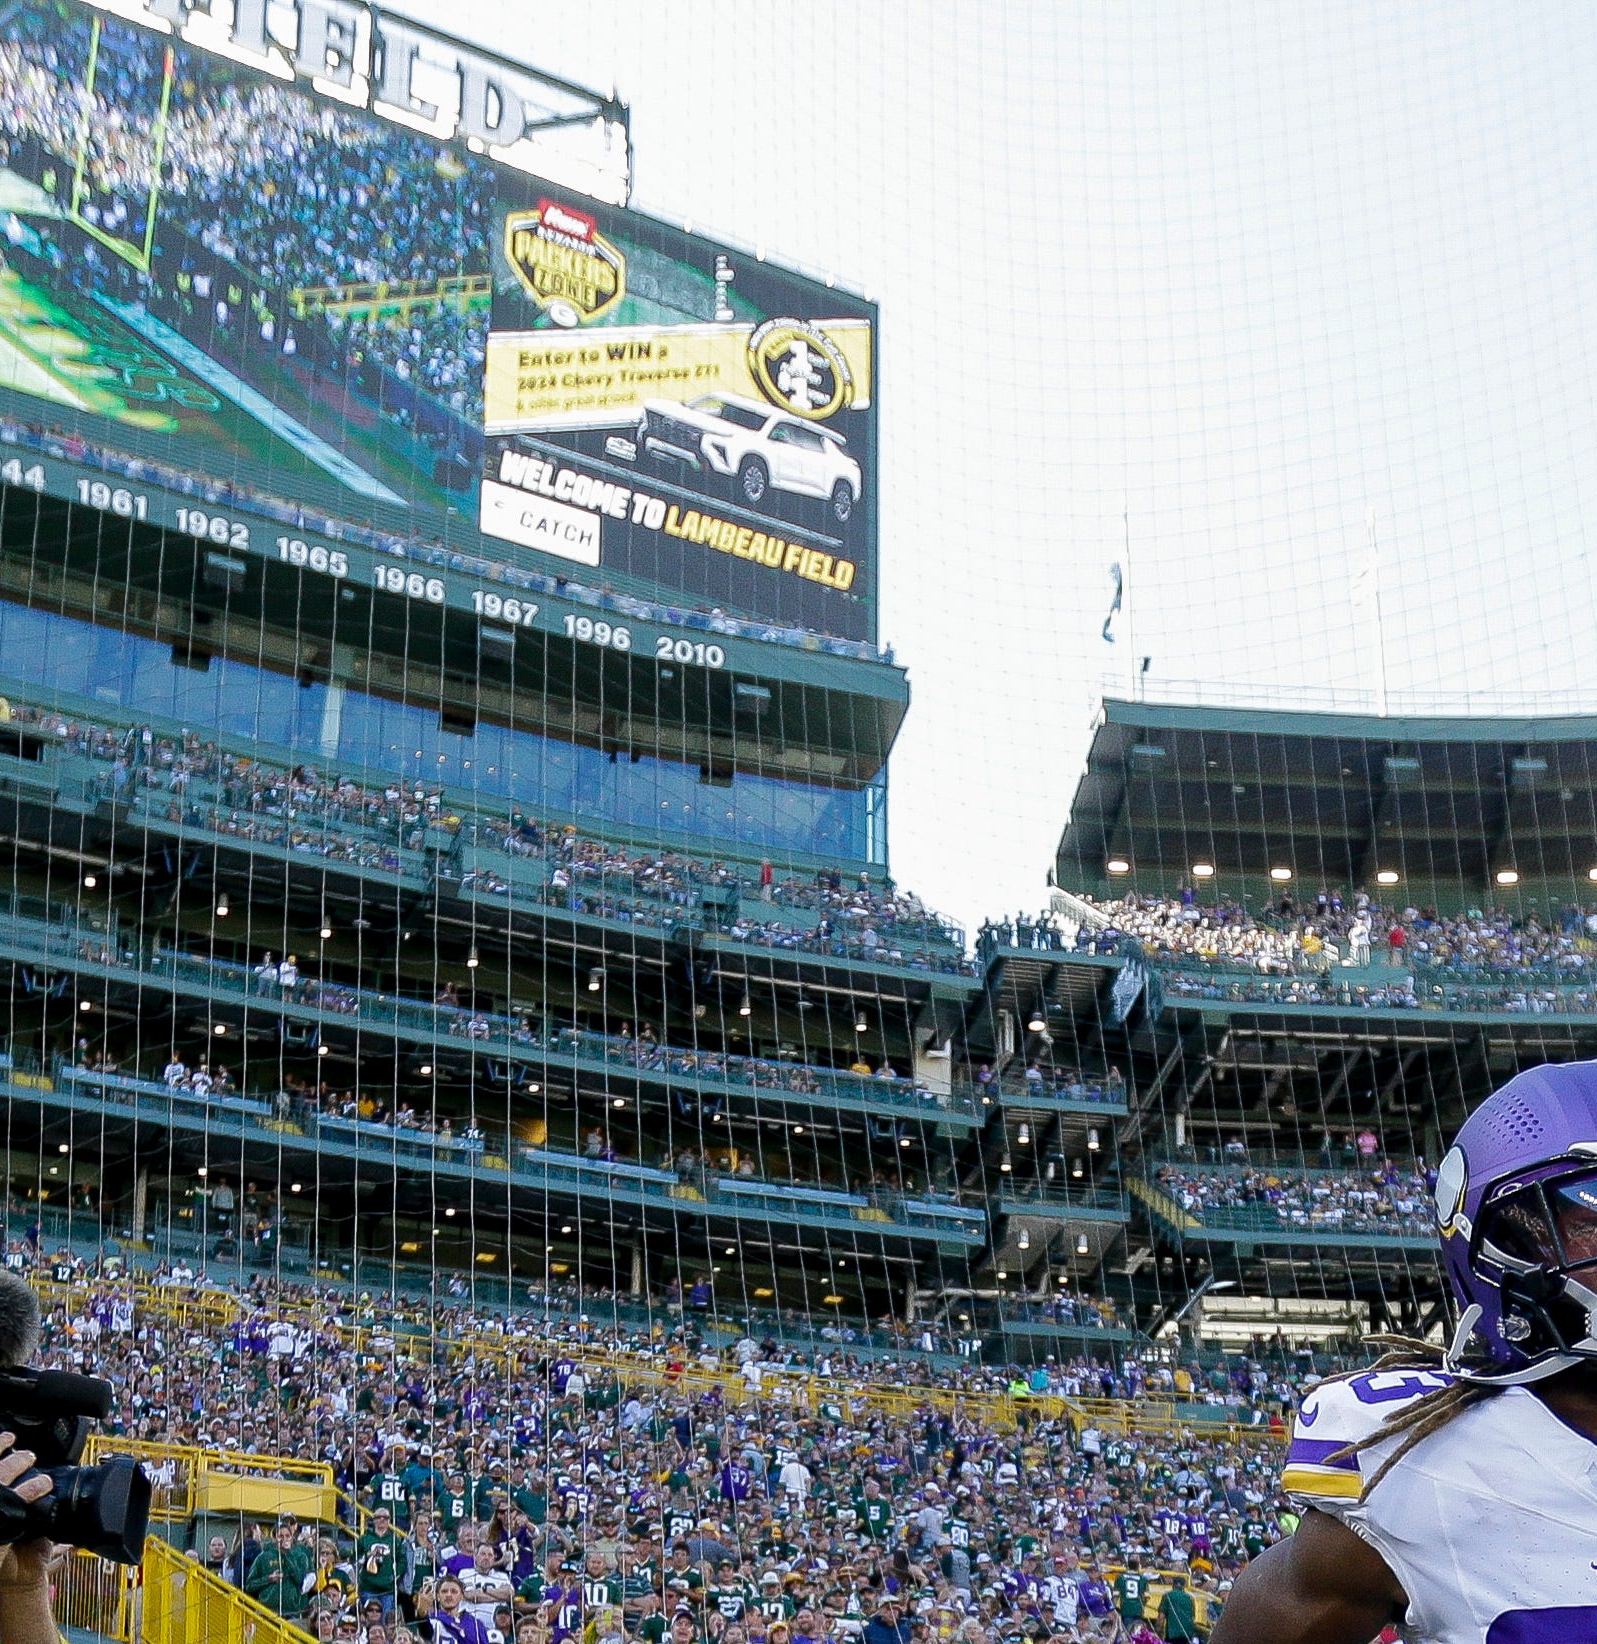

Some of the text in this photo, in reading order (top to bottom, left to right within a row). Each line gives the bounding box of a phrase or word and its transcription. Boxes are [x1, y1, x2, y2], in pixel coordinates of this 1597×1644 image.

[518, 350, 574, 367] Enter
[578, 347, 600, 365] to
[606, 341, 652, 360] WIN
[499, 449, 856, 591] WELCOME TO LAMBEAU FIELD
[519, 509, 594, 548] CATCH
[76, 478, 149, 521] 1961
[175, 507, 250, 551] 1962
[276, 535, 350, 579] 1965
[373, 564, 446, 604] 1966
[471, 588, 540, 627] 1967
[563, 613, 632, 652] 1996
[655, 636, 725, 668] 2010
